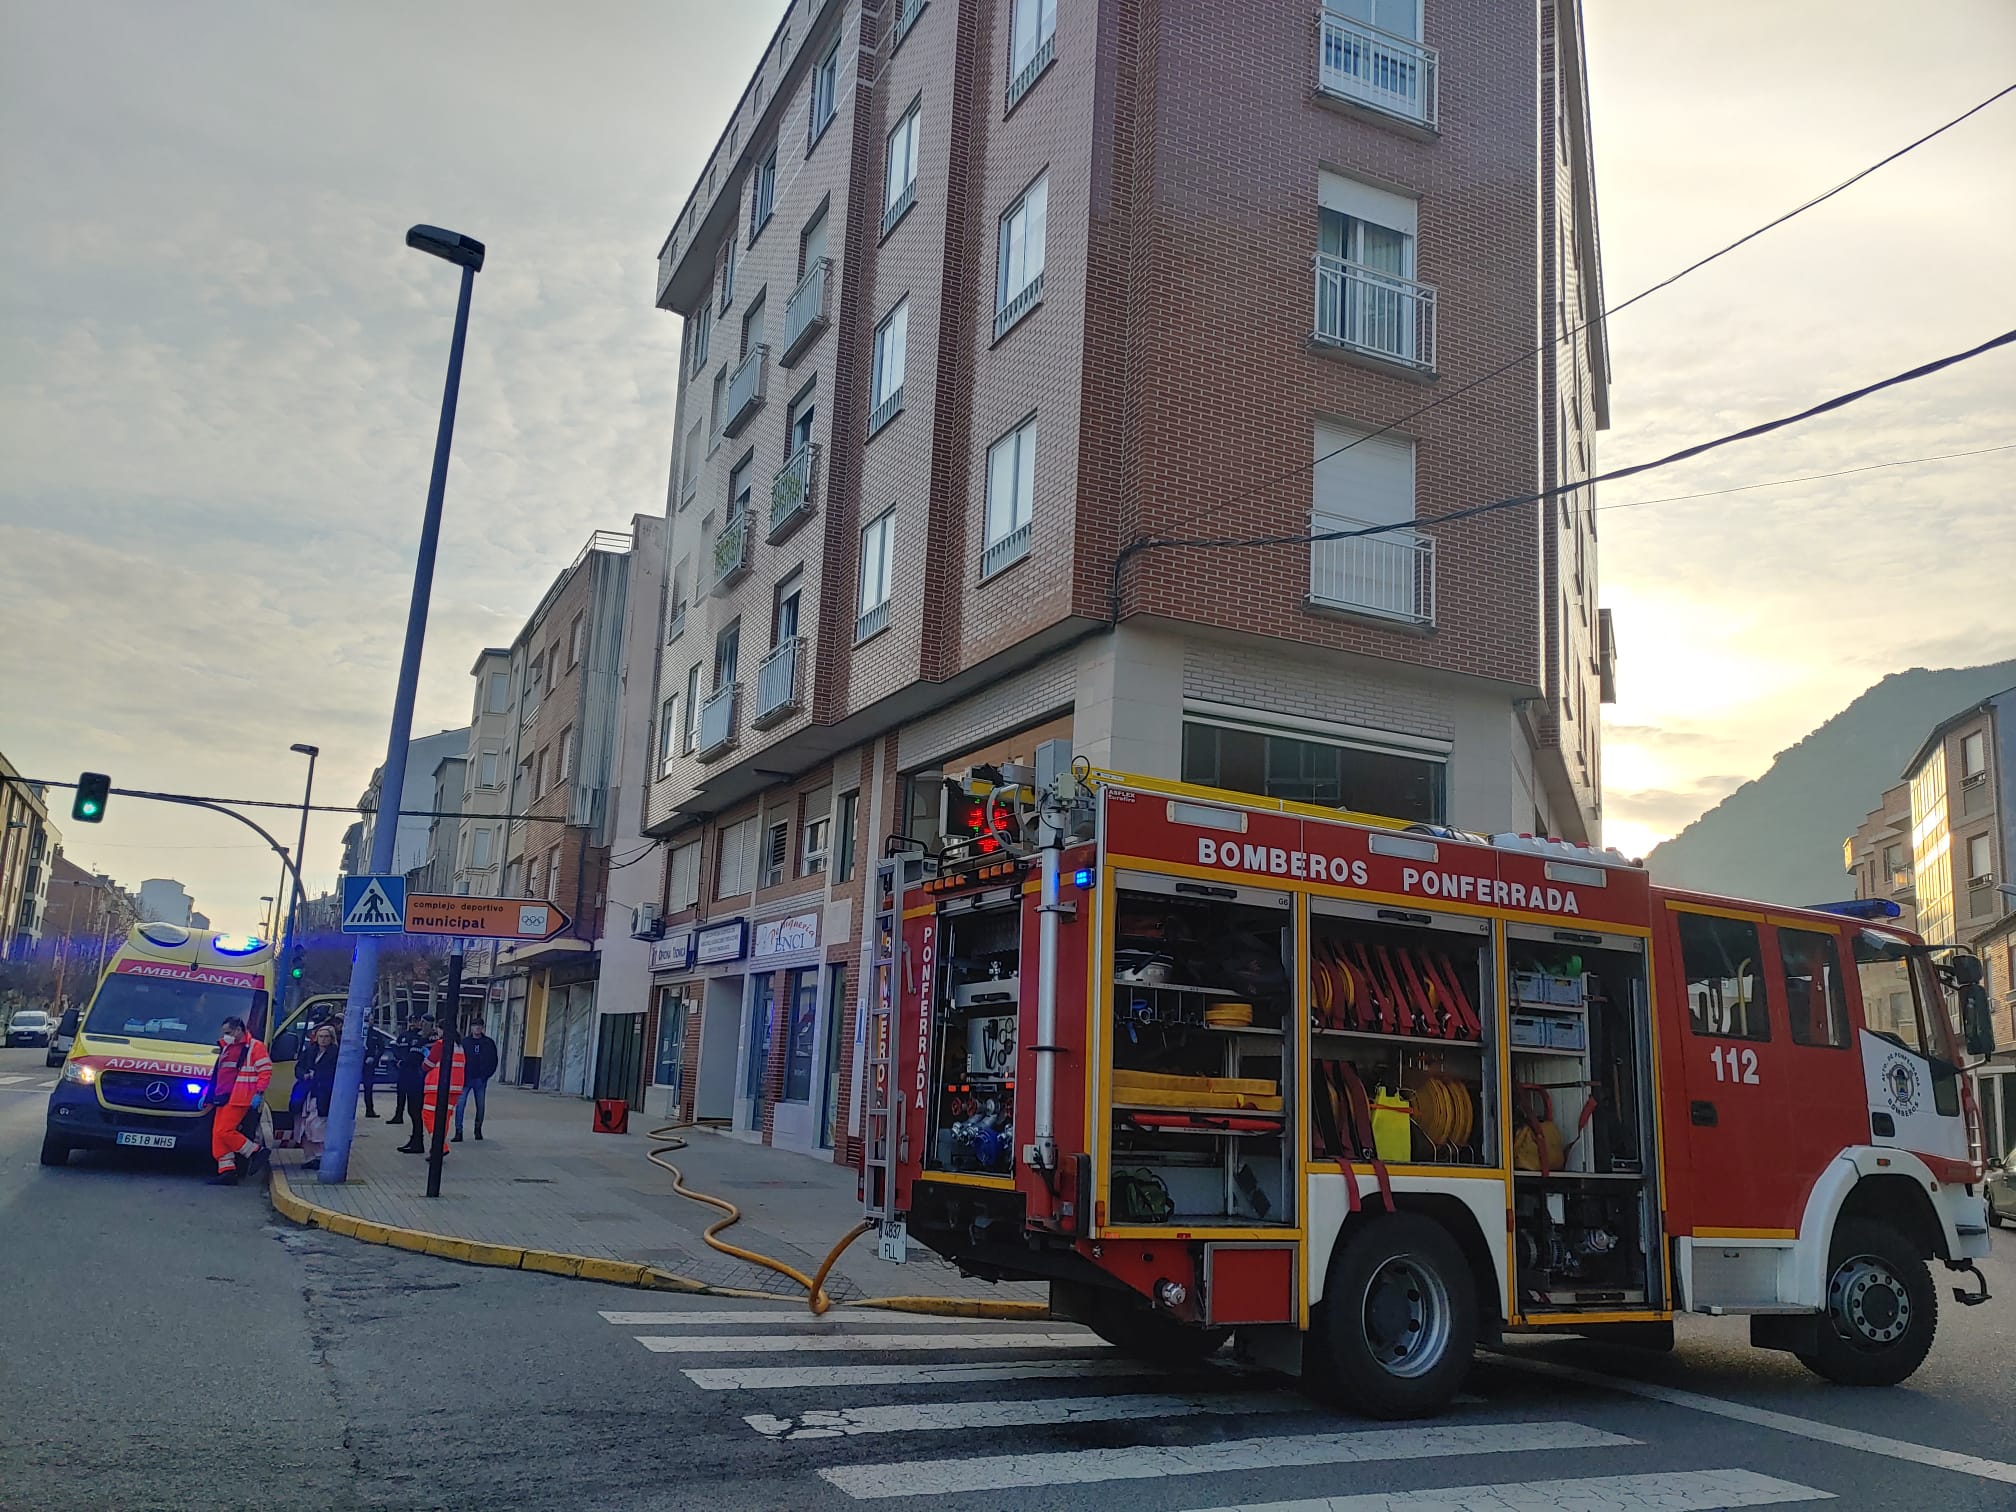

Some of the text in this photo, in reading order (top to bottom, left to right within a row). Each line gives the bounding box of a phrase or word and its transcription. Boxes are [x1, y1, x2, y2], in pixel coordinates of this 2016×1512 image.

[1198, 837, 1580, 915] BOMBEROS PONFERRADA
[413, 901, 504, 912] complejo deportivo
[411, 915, 486, 930] municipal
[128, 965, 253, 987] AMBULANCIA
[915, 926, 933, 1109] PONFERRADA
[1710, 1045, 1760, 1085] 112
[1887, 1098, 1919, 1117] BOMBEROS
[124, 1134, 173, 1147] 6518 MHS
[884, 1221, 902, 1240] 4837
[884, 1243, 898, 1260] FLL
